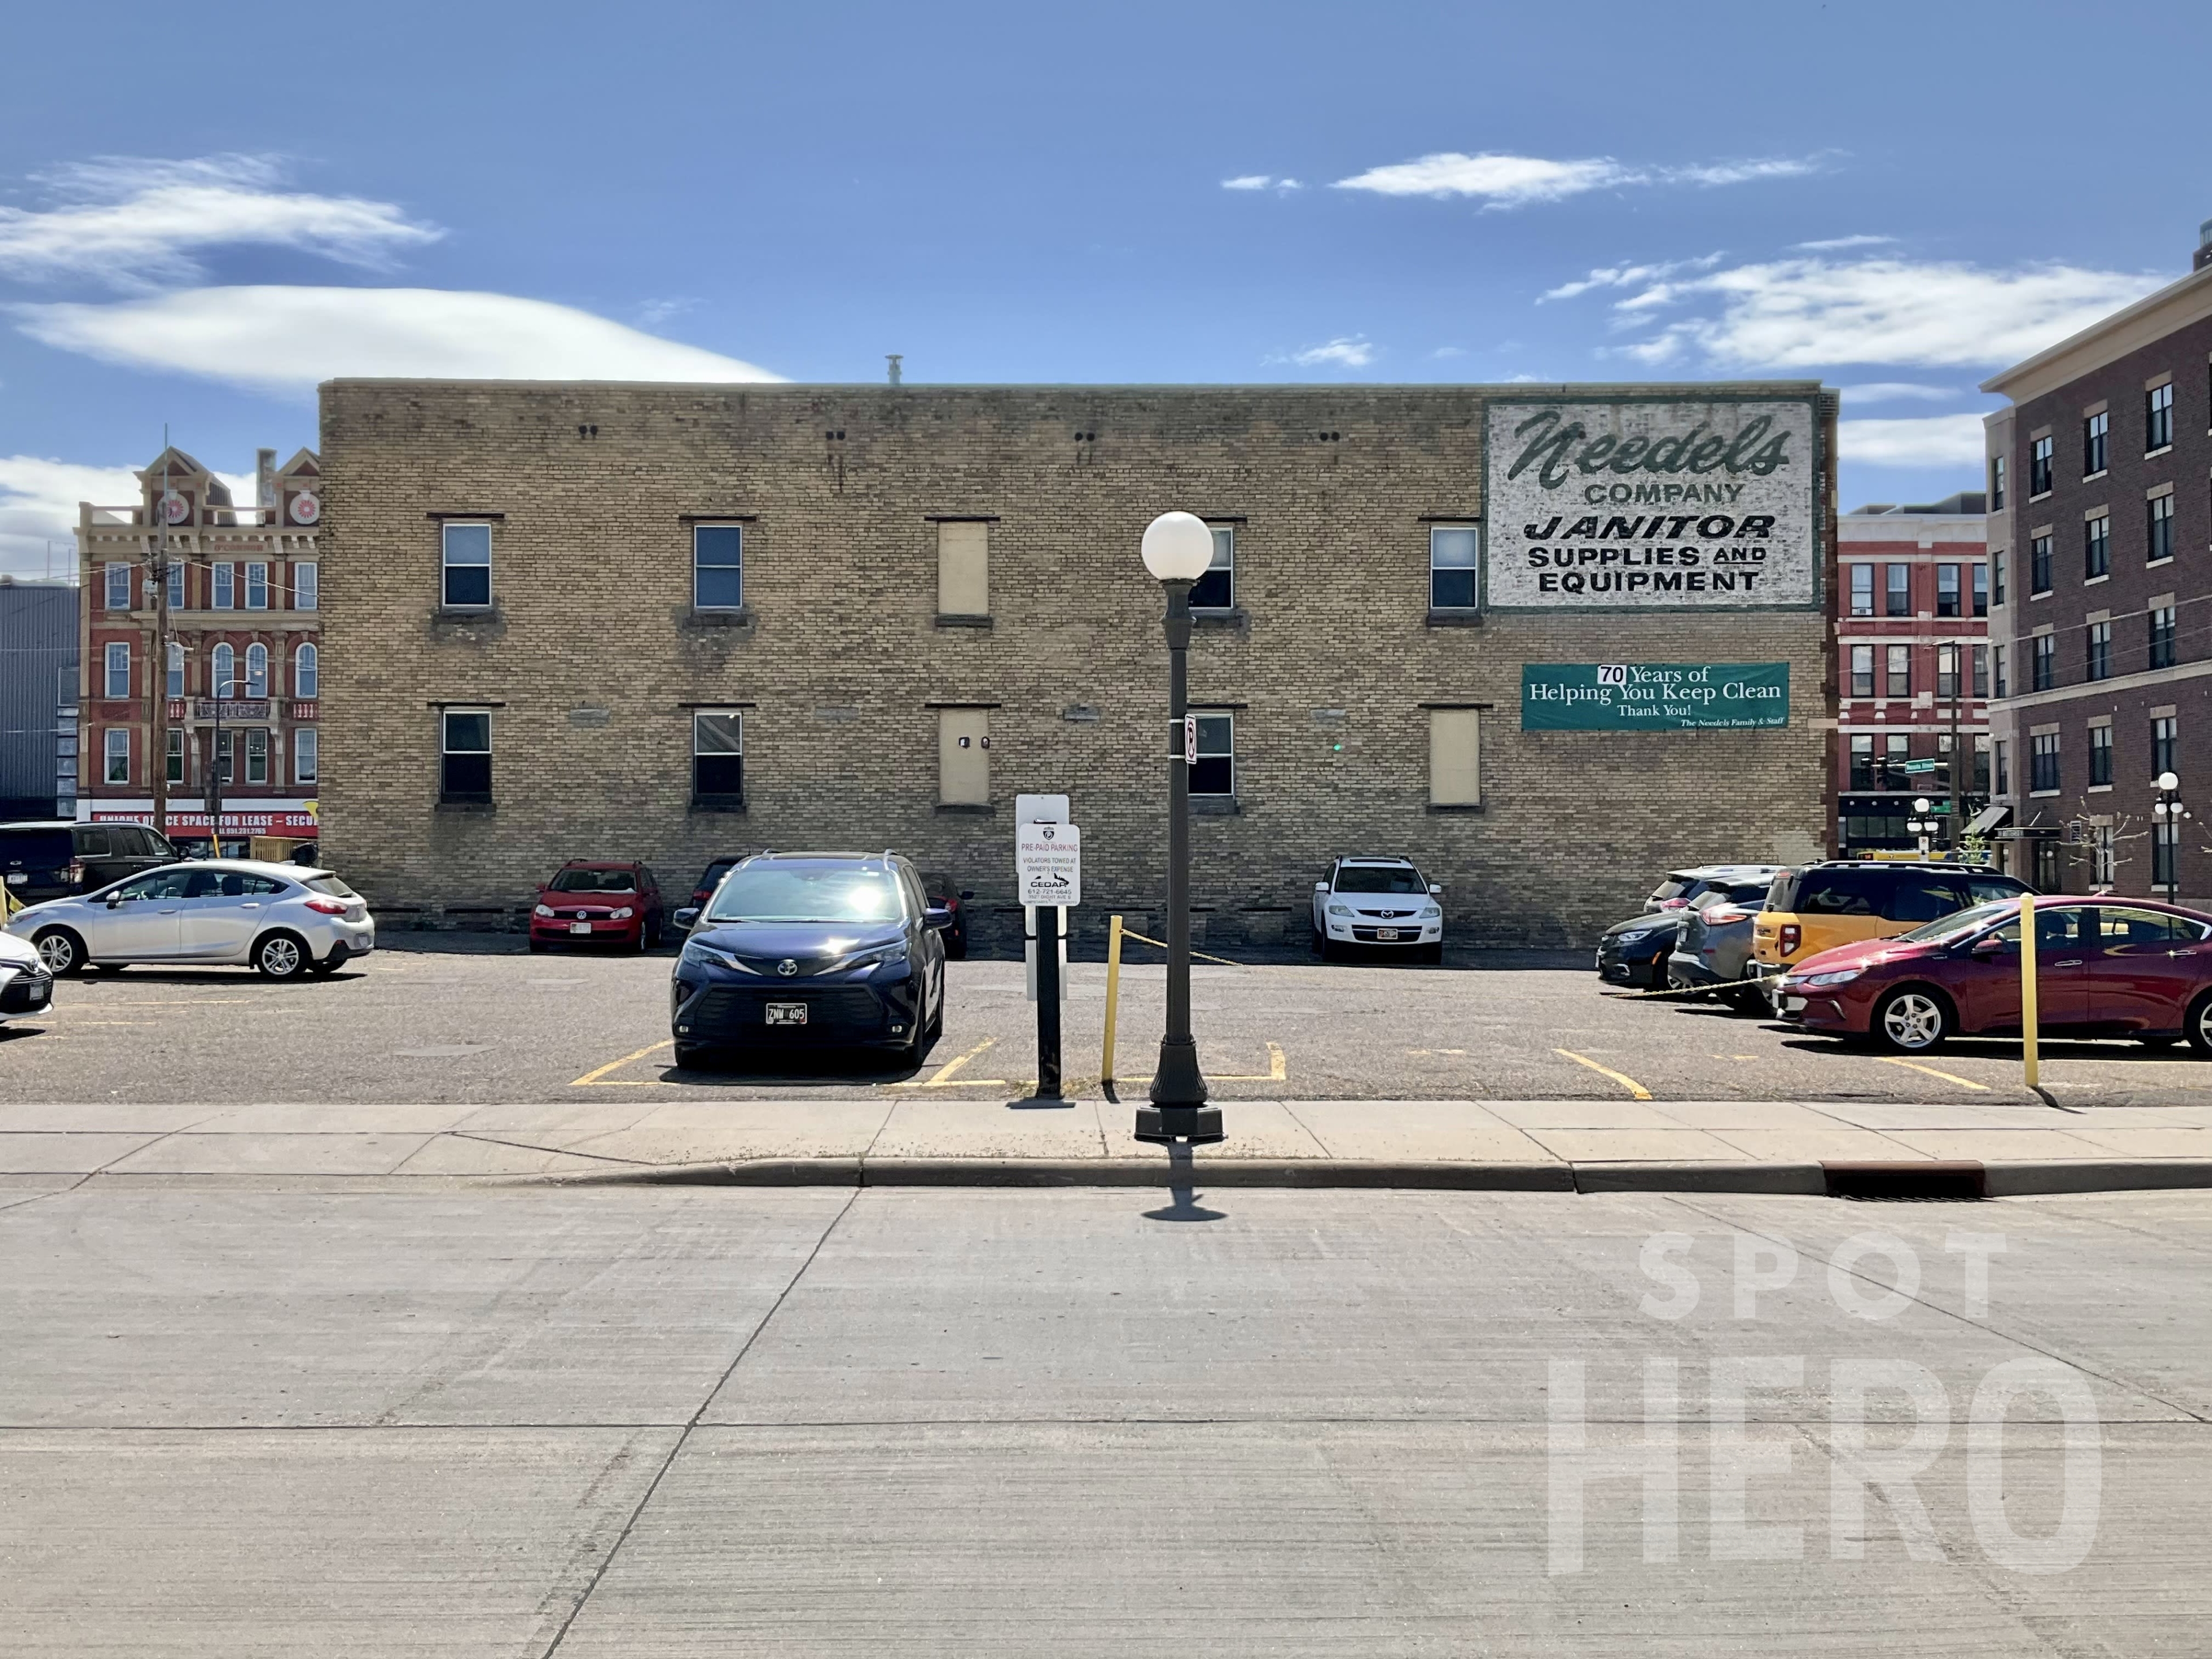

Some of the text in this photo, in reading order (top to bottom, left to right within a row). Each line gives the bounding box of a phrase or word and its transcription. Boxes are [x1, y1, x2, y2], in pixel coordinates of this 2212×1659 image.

[1508, 411, 1791, 489] Needels
[1585, 483, 1744, 505] COMPANY
[1524, 515, 1775, 540] JANITOR
[1528, 547, 1766, 567] SUPPLIES AND
[1539, 572, 1759, 594] EQUIPMENT
[1601, 666, 1711, 683] 70 Years of
[1530, 682, 1781, 705] Helping You Keep Clean
[1618, 704, 1691, 716] Thank You!
[1732, 718, 1756, 727] Family
[142, 815, 178, 826] OFCE
[182, 815, 215, 826] SPACE
[219, 815, 238, 826] FOR
[242, 815, 272, 826] LEASE
[1021, 843, 1078, 852] PRE-PAID PARKING
[789, 1008, 805, 1019] 605
